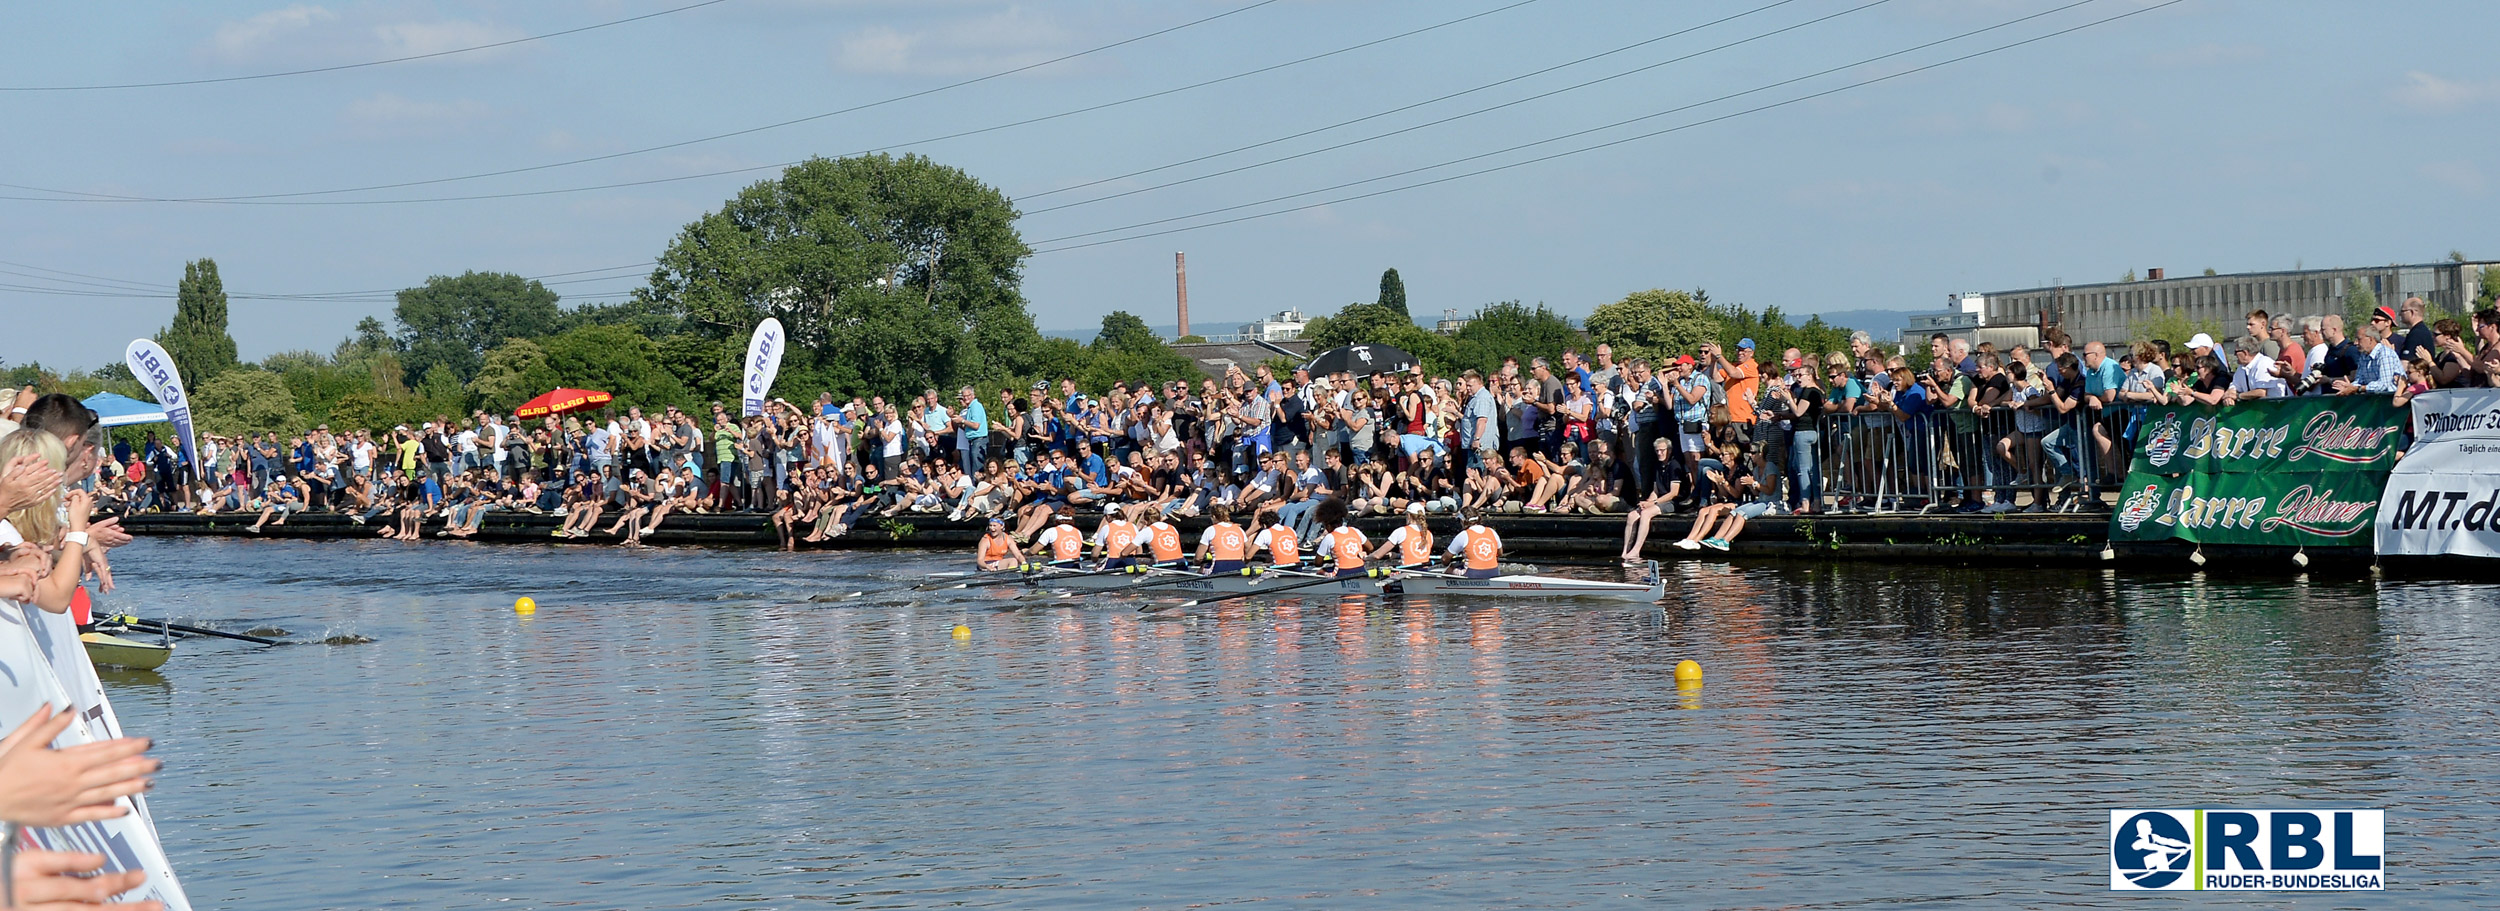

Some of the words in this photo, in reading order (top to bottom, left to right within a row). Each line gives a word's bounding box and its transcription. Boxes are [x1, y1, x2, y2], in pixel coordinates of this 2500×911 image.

[755, 330, 775, 372] RBL
[552, 397, 584, 411] DLRG
[587, 394, 608, 402] DLRG
[520, 406, 548, 416] DLRG
[2424, 412, 2486, 434] Mindener
[2183, 416, 2289, 460] Barre
[2288, 410, 2399, 463] Pilsener
[2459, 444, 2485, 454] Täglich
[1651, 561, 1657, 577] 4
